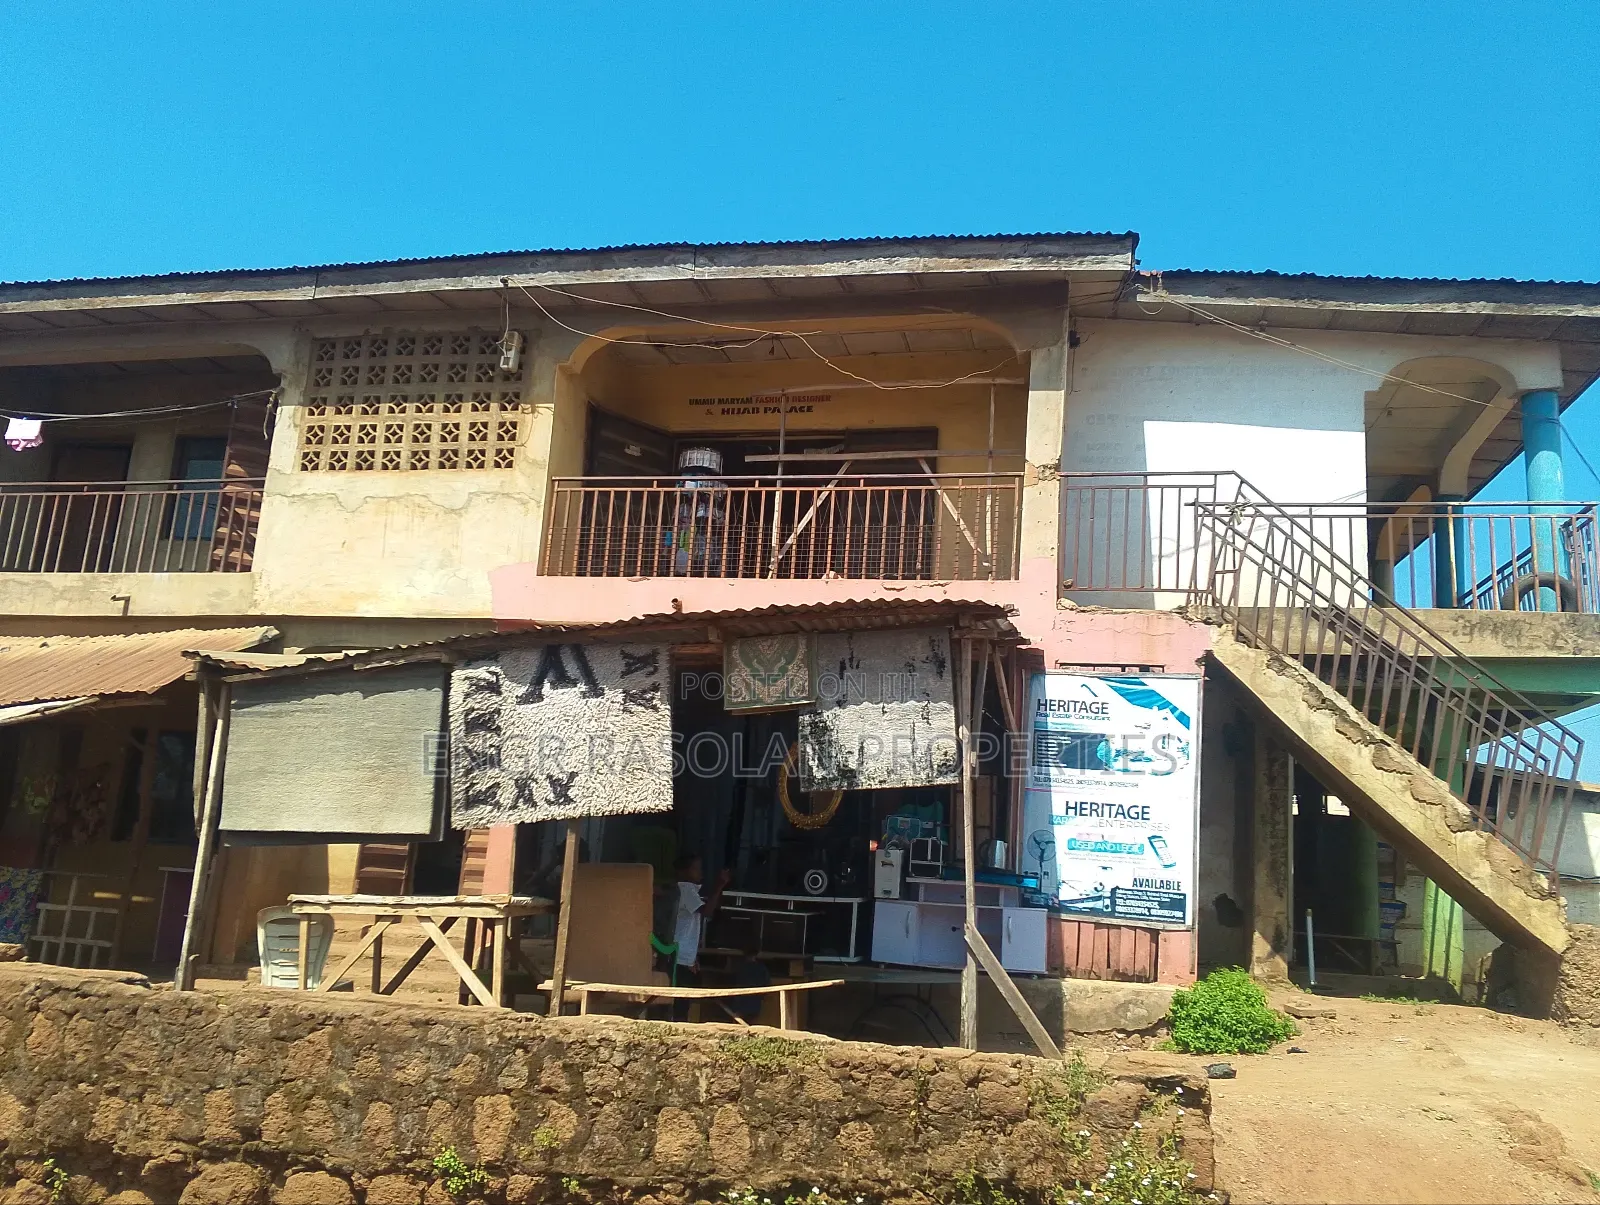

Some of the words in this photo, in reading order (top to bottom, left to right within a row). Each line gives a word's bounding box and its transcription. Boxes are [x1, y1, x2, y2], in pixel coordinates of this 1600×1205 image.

[688, 398, 715, 406] UMMU
[717, 397, 753, 405] MARYAM
[792, 394, 832, 403] DESIGNER
[705, 408, 715, 416] &
[721, 407, 761, 415] HIJAB
[763, 405, 814, 414] PAACE
[1036, 699, 1109, 714] HERITAGE
[1065, 801, 1150, 820] HERITAGE
[1096, 842, 1116, 851] AND
[1132, 878, 1181, 891] AVAILABLE
